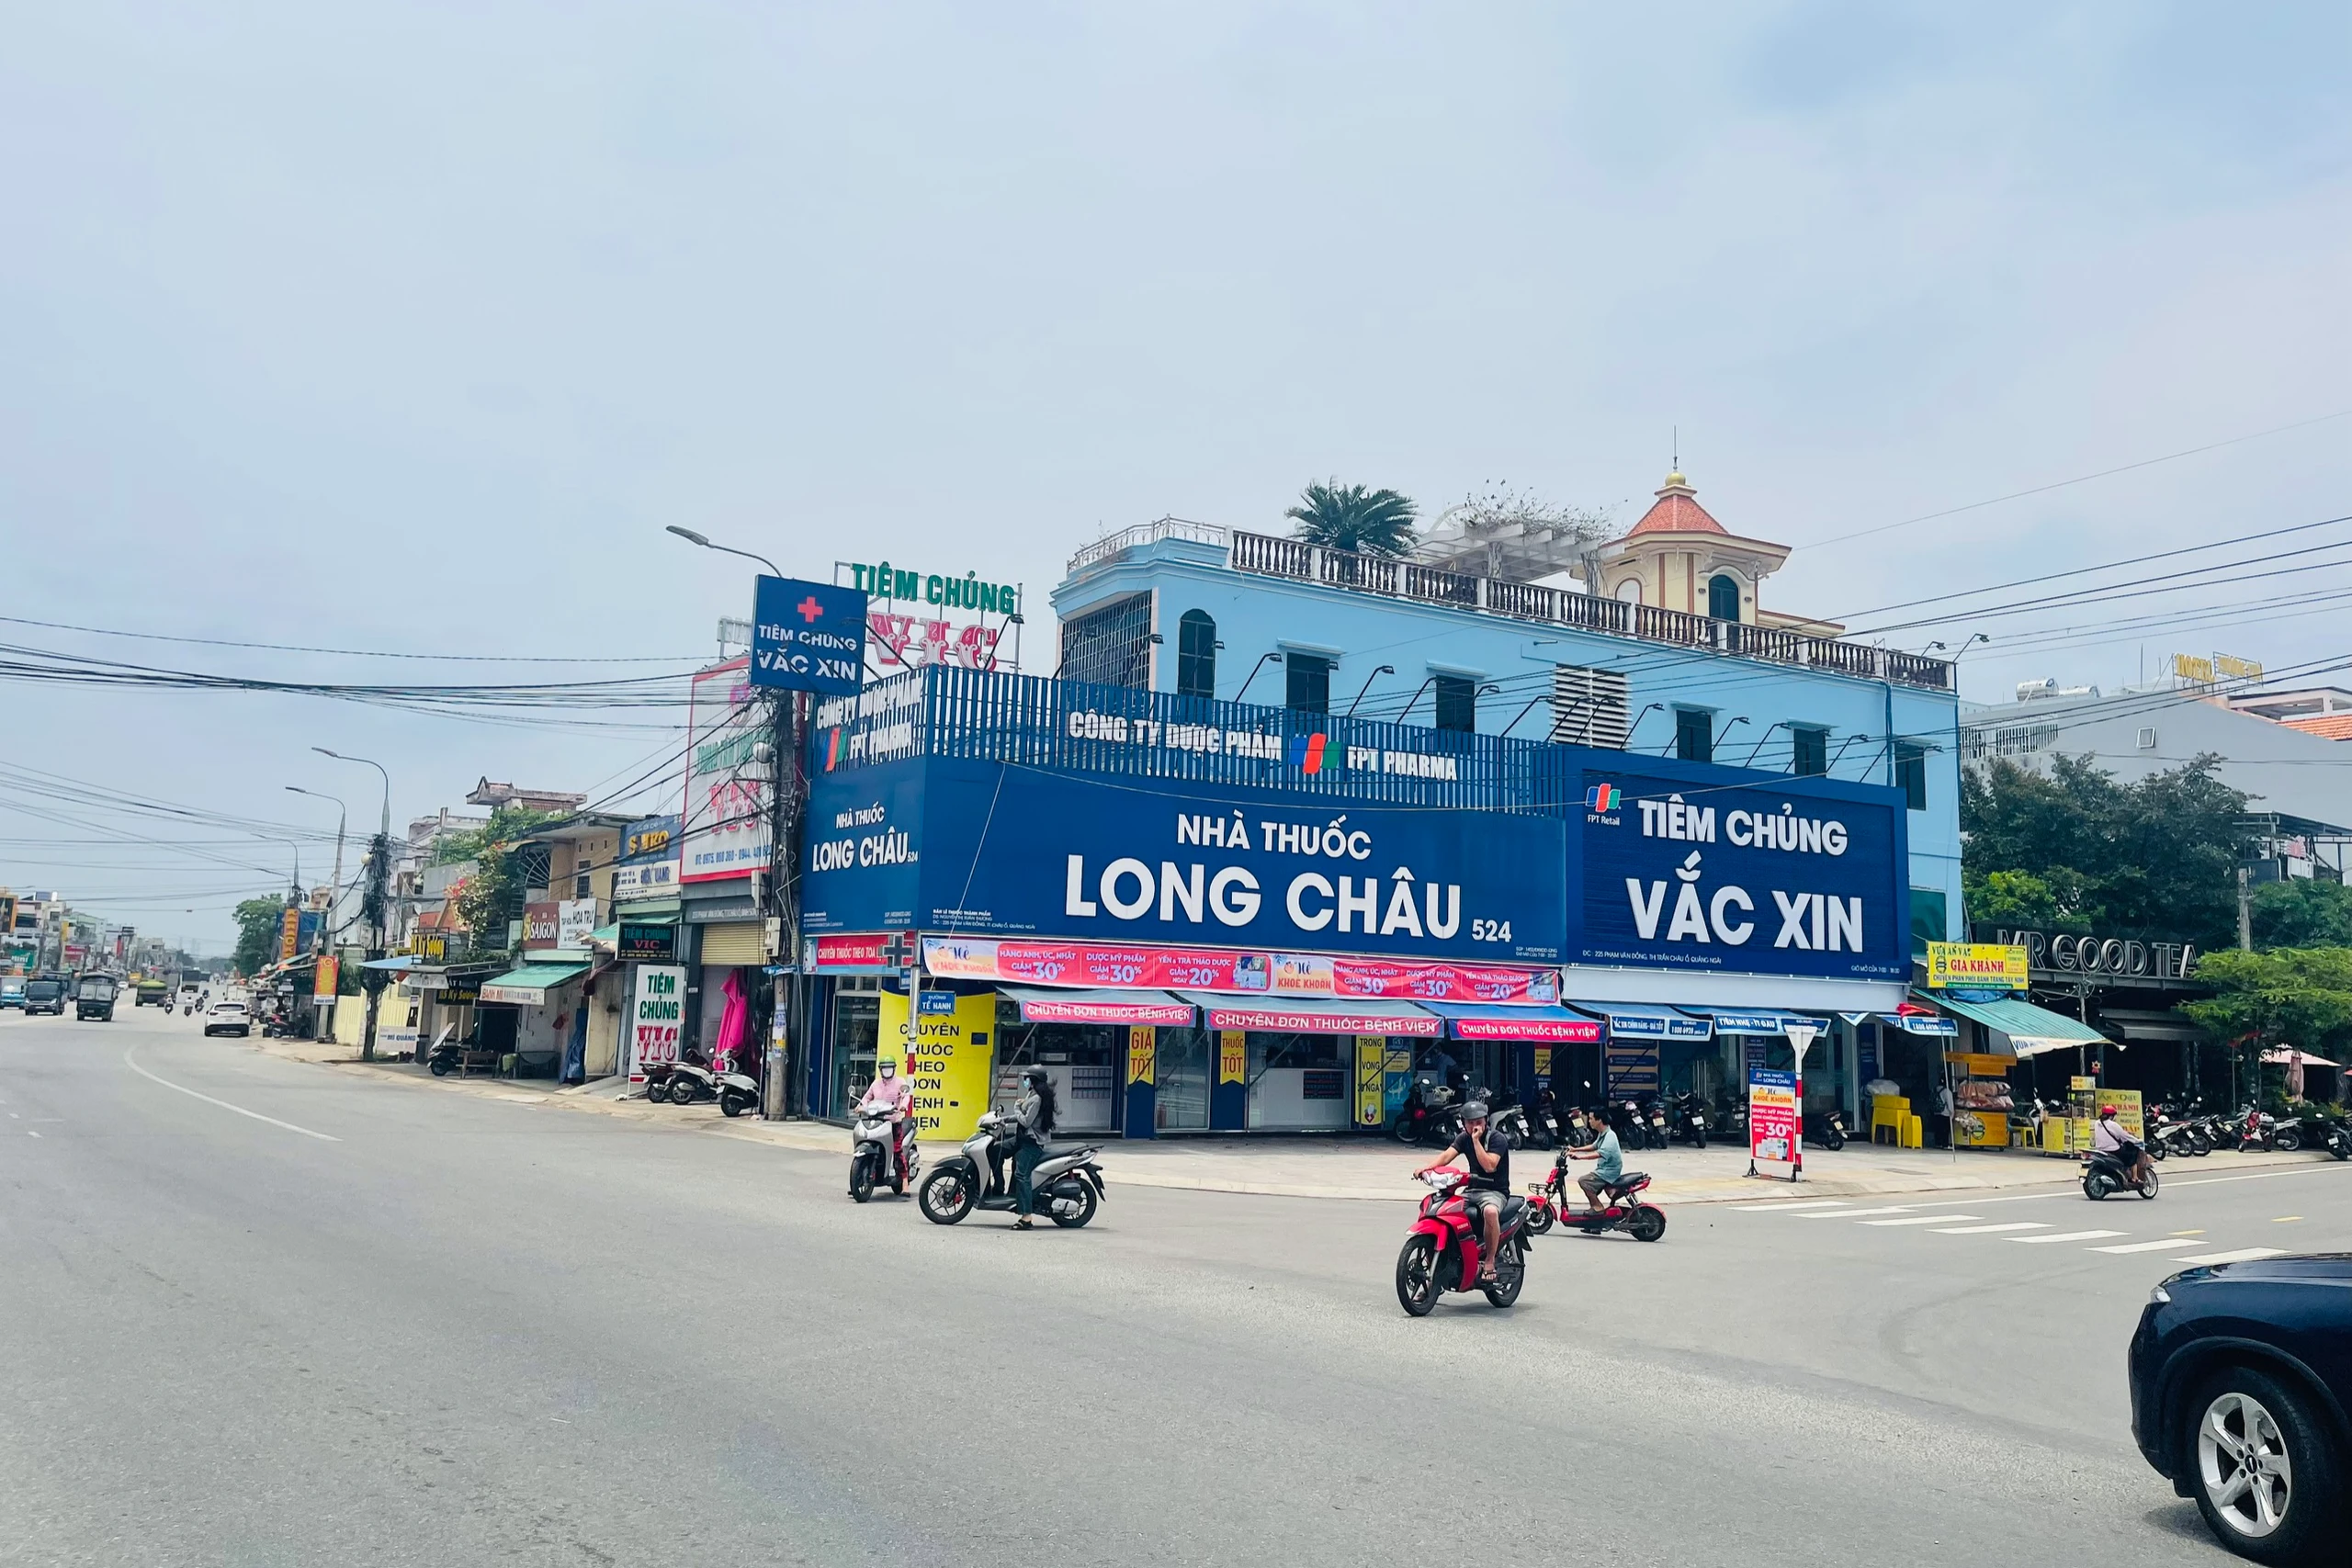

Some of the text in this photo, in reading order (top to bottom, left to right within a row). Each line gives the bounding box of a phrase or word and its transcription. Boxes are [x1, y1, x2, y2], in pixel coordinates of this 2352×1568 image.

[851, 561, 1014, 615] TIÊM CHỦNG
[759, 623, 857, 651] TIÊM CHỦNG
[866, 613, 998, 673] VIC
[817, 658, 856, 682] XIN
[1068, 710, 1457, 781] CÔNG TY DƯỢC PHẨM FPT PHARMA
[836, 801, 885, 829] NHÀ THUỐC
[1588, 814, 1621, 826] FPT Retail
[1637, 794, 1849, 856] TIÊM CHỦNG
[1177, 808, 1372, 860] NHÀ THUỐC
[812, 826, 919, 872] LONG CHÂU 524
[1065, 854, 1512, 942] LONG CHÂU 524
[1625, 850, 1863, 953] VẮC XIN
[530, 919, 557, 940] SAIGON
[634, 940, 660, 949] VIC
[853, 947, 865, 958] THEO
[1000, 949, 1022, 958] HÀNG
[1023, 951, 1042, 960] ANH,
[1178, 956, 1192, 964] TRÀ
[1951, 959, 1968, 972] GIA
[2052, 934, 2148, 977] GOOD
[2152, 942, 2199, 978] TEA
[648, 972, 675, 994] TIÊM
[1032, 961, 1065, 980] 30%
[1110, 964, 1142, 983] 30%
[1189, 967, 1219, 986] 20%
[1362, 977, 1389, 994] 30%
[1426, 980, 1453, 997] 30%
[1490, 985, 1516, 999] 20%
[639, 995, 679, 1020] CHỦNG
[1027, 1004, 1071, 1016] CHUYÊN
[900, 1022, 960, 1036] CUYÊN
[1215, 1013, 1274, 1027] CHUYÊN
[1278, 1017, 1309, 1028] ĐƠN
[1364, 1019, 1402, 1032] BỆNH
[1462, 1023, 1596, 1039] CHUYÊN ĐƠN THUỐC BỆNH VIỆN
[1718, 1017, 1735, 1026] TIÊM
[1736, 1019, 1750, 1028] NHẸ
[637, 1025, 678, 1061] VIC
[1131, 1027, 1152, 1050] GIÁ
[1222, 1036, 1244, 1049] THUỐC
[1360, 1038, 1382, 1047] TRONG
[905, 1060, 945, 1072] HEO
[1131, 1053, 1151, 1076] TỐT
[1222, 1053, 1243, 1074] TỐT
[914, 1115, 940, 1131] IỆN
[1766, 1122, 1792, 1137] 30%
